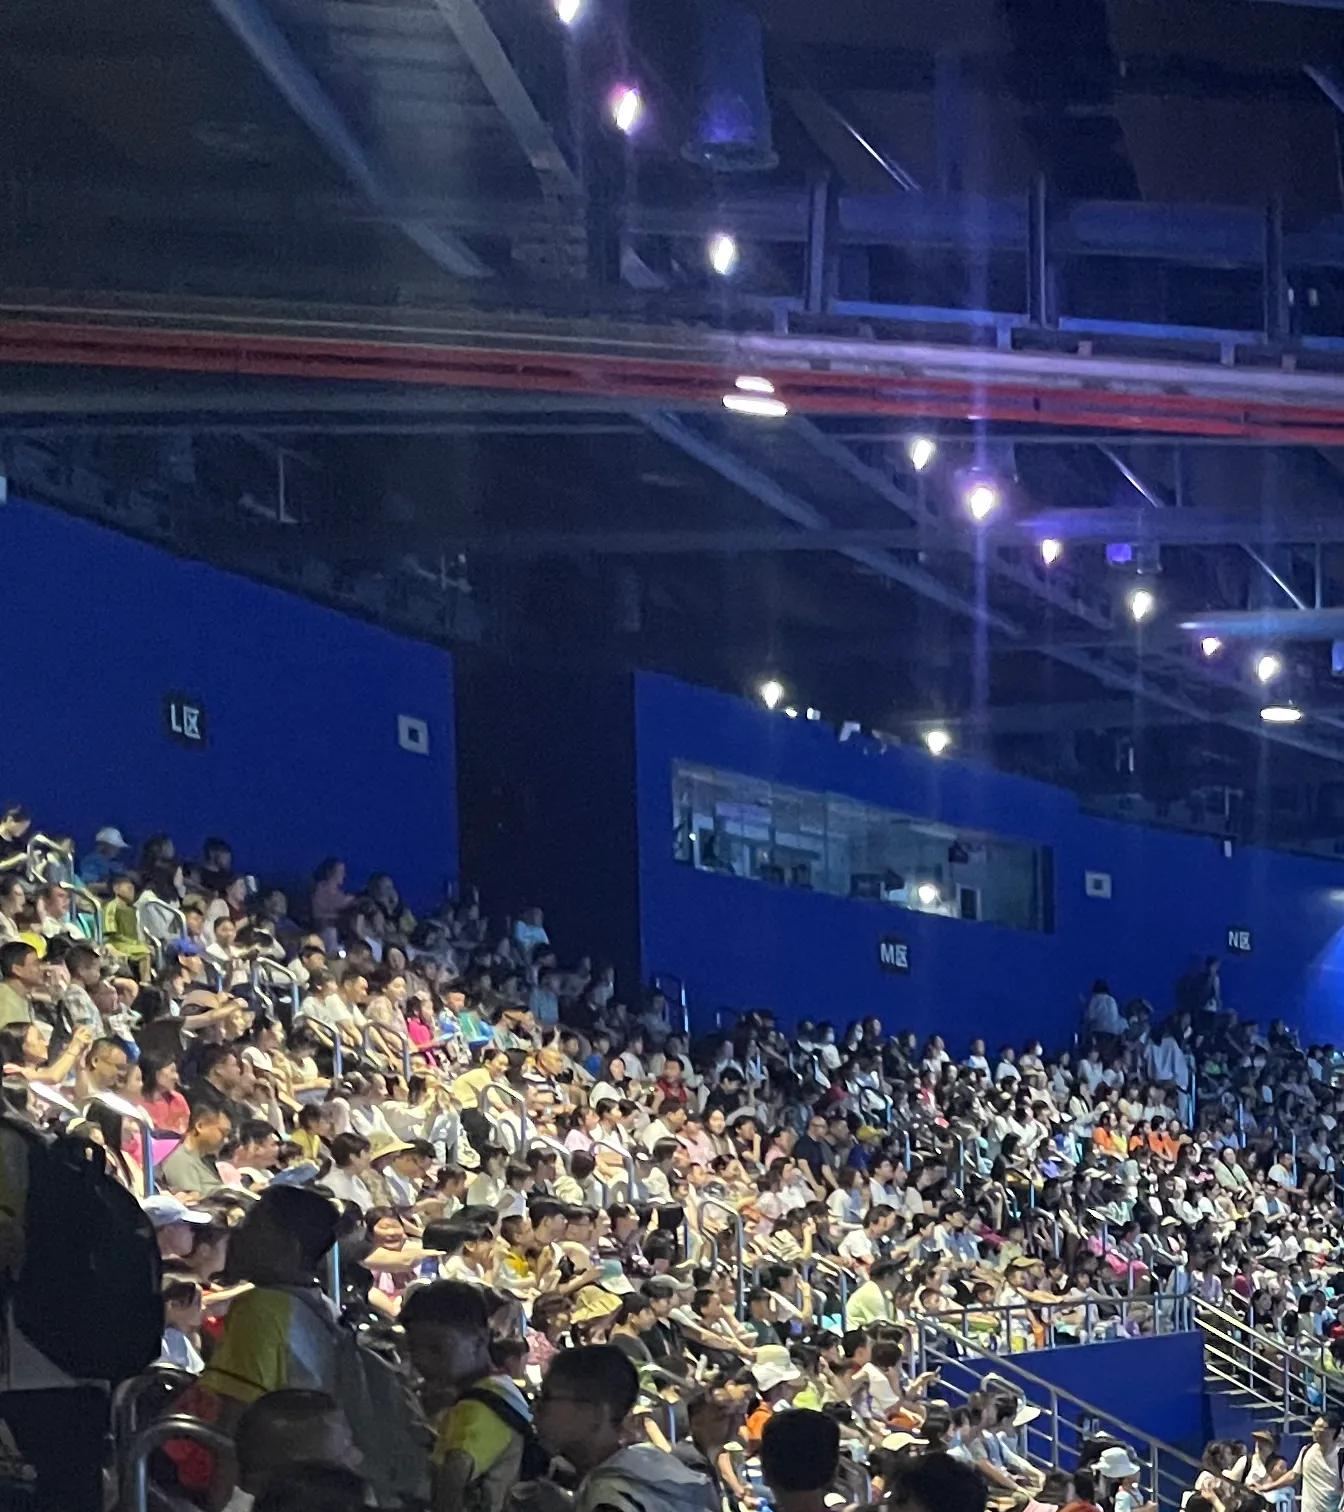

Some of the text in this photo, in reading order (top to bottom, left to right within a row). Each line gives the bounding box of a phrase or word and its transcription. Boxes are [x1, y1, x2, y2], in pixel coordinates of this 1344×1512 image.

[170, 703, 200, 740] L区
[1228, 930, 1251, 950] N区
[880, 943, 908, 968] M区
